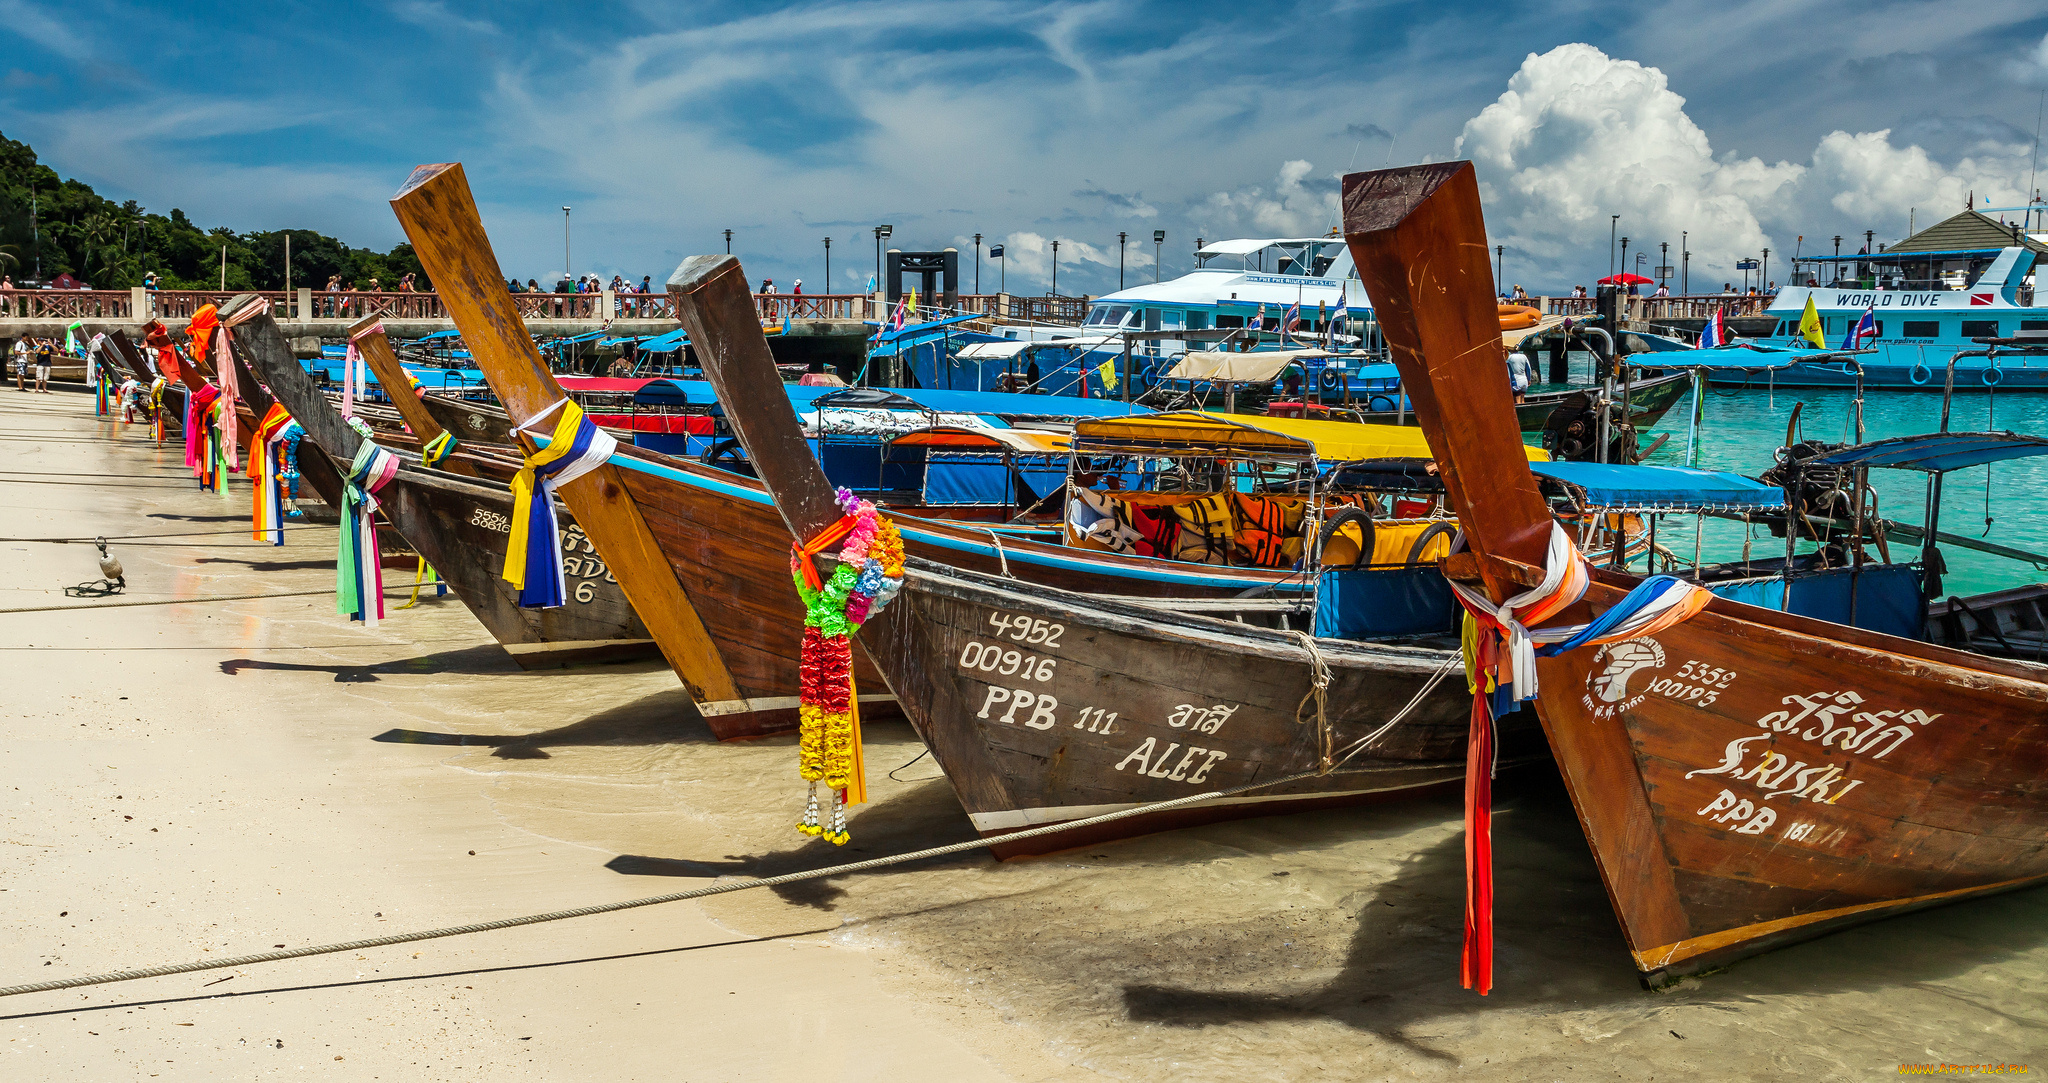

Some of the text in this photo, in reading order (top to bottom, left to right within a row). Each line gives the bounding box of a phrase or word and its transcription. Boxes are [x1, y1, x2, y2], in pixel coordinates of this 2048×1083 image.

[1837, 294, 1941, 306] WORLD DIVE
[471, 518, 511, 533] 00616
[474, 508, 508, 525] 5554
[575, 581, 597, 603] 6
[989, 611, 1065, 648] 4952
[959, 641, 1056, 682] 00916
[1674, 659, 1737, 689] 5352
[976, 685, 1119, 735] PPB 111
[1115, 737, 1228, 785] ALEE
